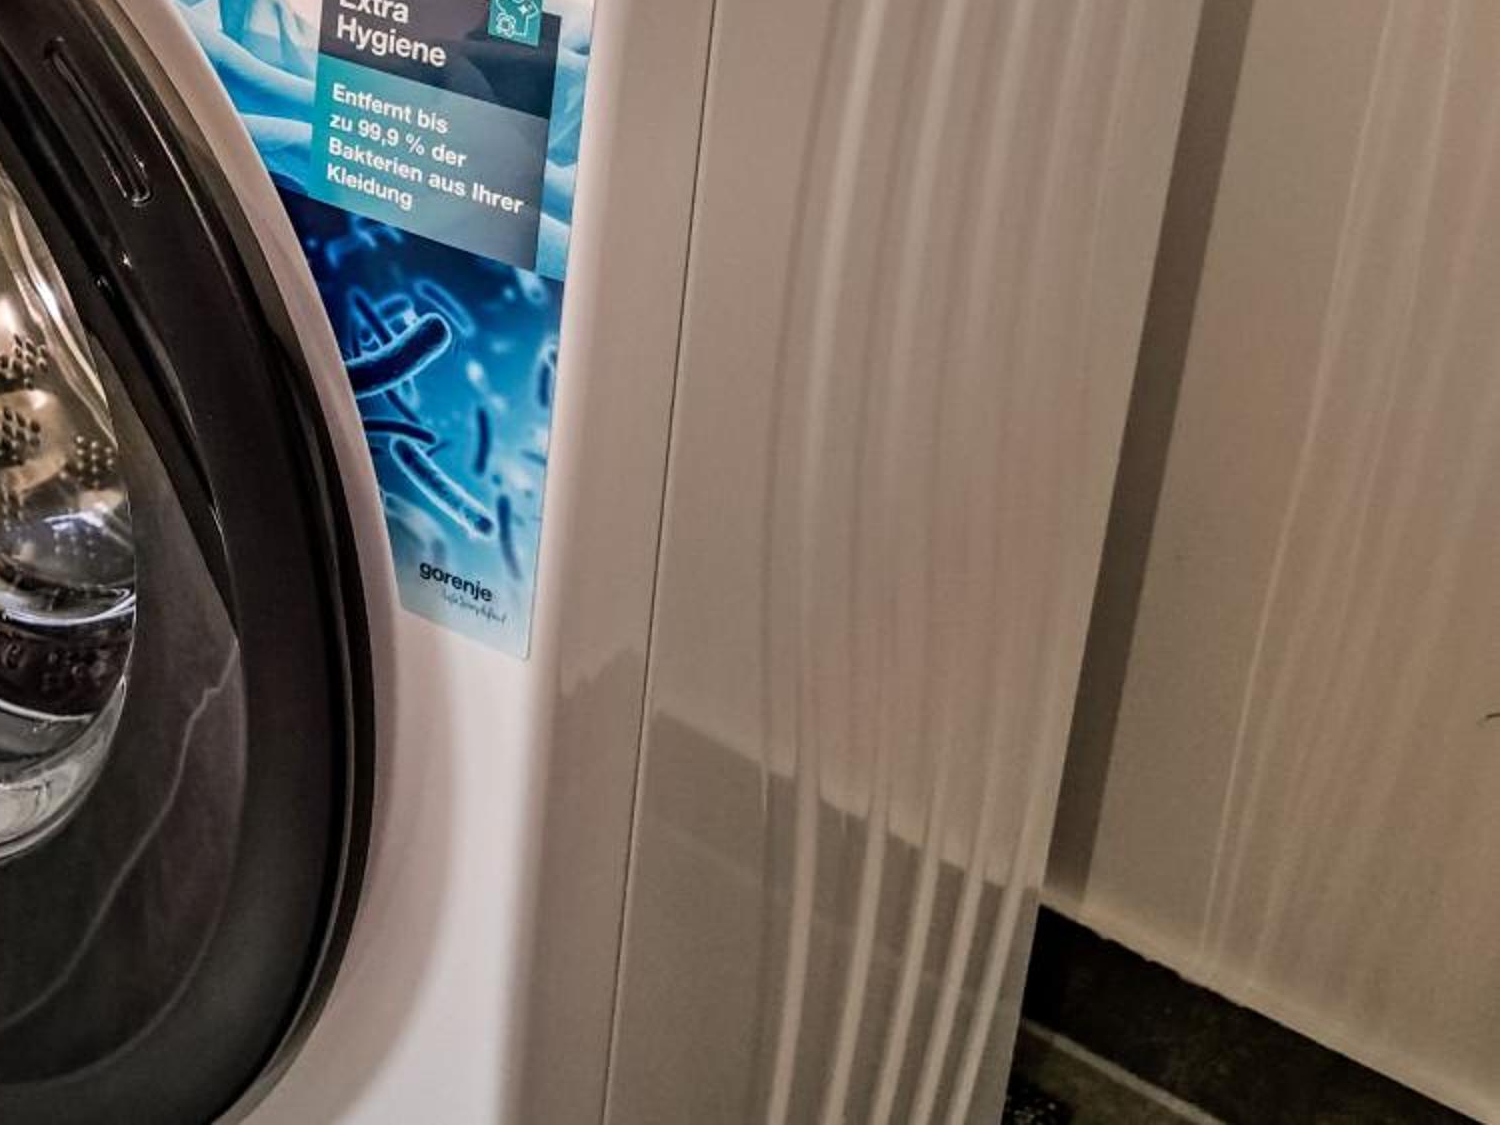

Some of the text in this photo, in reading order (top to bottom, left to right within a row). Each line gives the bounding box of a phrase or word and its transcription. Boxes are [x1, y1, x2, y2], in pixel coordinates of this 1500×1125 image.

[336, 14, 446, 68] Hygiene
[332, 83, 449, 134] Entfernt bis
[330, 114, 468, 168] zu 99,9 % der
[326, 163, 414, 211] Kleidung
[328, 136, 525, 215] Bakterien aus Ihrer
[418, 561, 493, 602] gorenje
